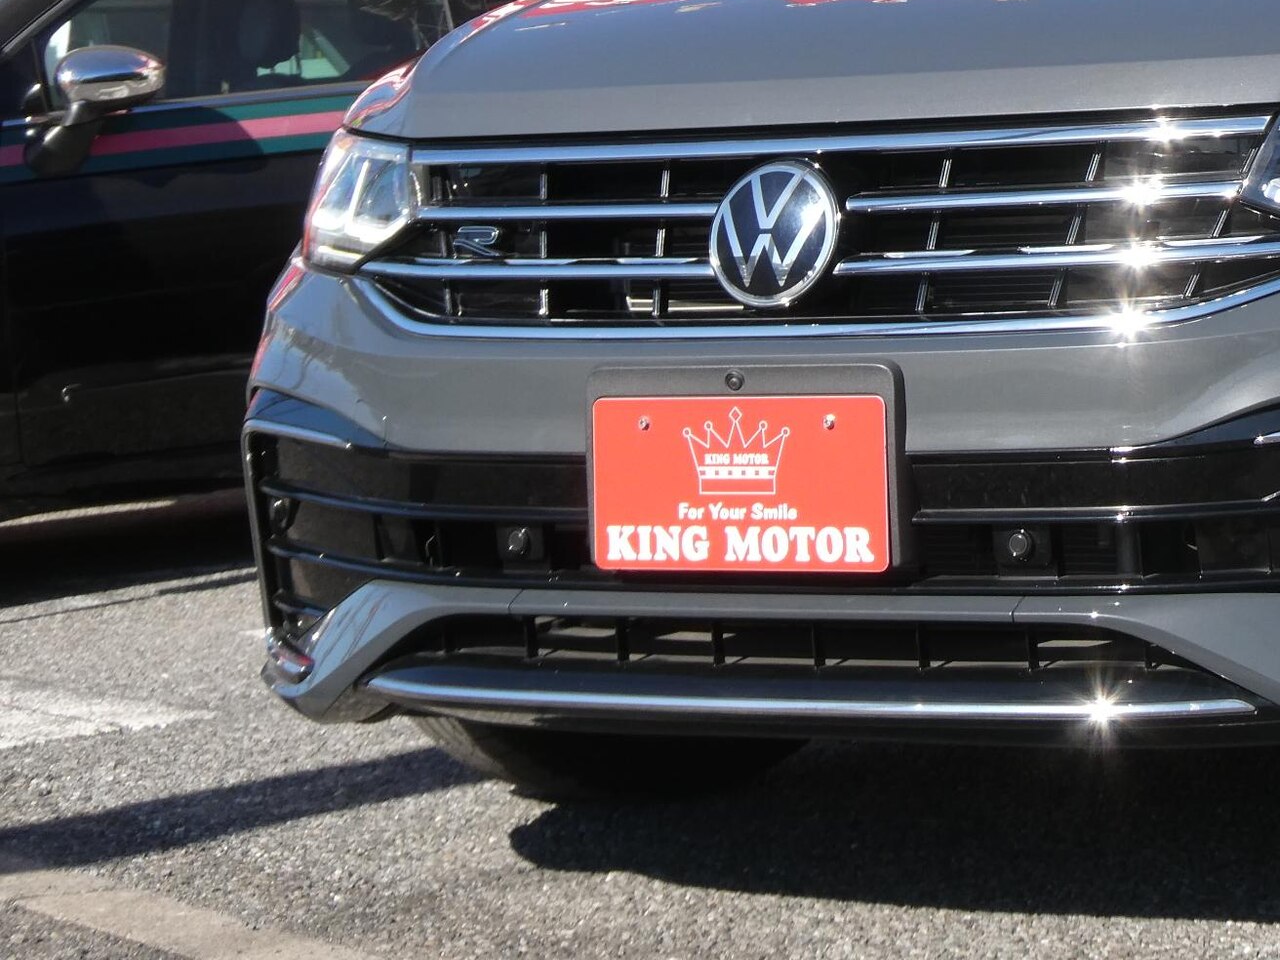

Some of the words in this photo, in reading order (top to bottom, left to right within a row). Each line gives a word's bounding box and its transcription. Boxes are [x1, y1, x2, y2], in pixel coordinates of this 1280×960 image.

[705, 453, 730, 465] KING
[733, 453, 769, 465] MOTOR
[679, 503, 704, 520] For
[709, 503, 746, 520] Your
[751, 503, 797, 520] Smile
[606, 525, 709, 561] KING
[725, 526, 874, 563] MOTOR
